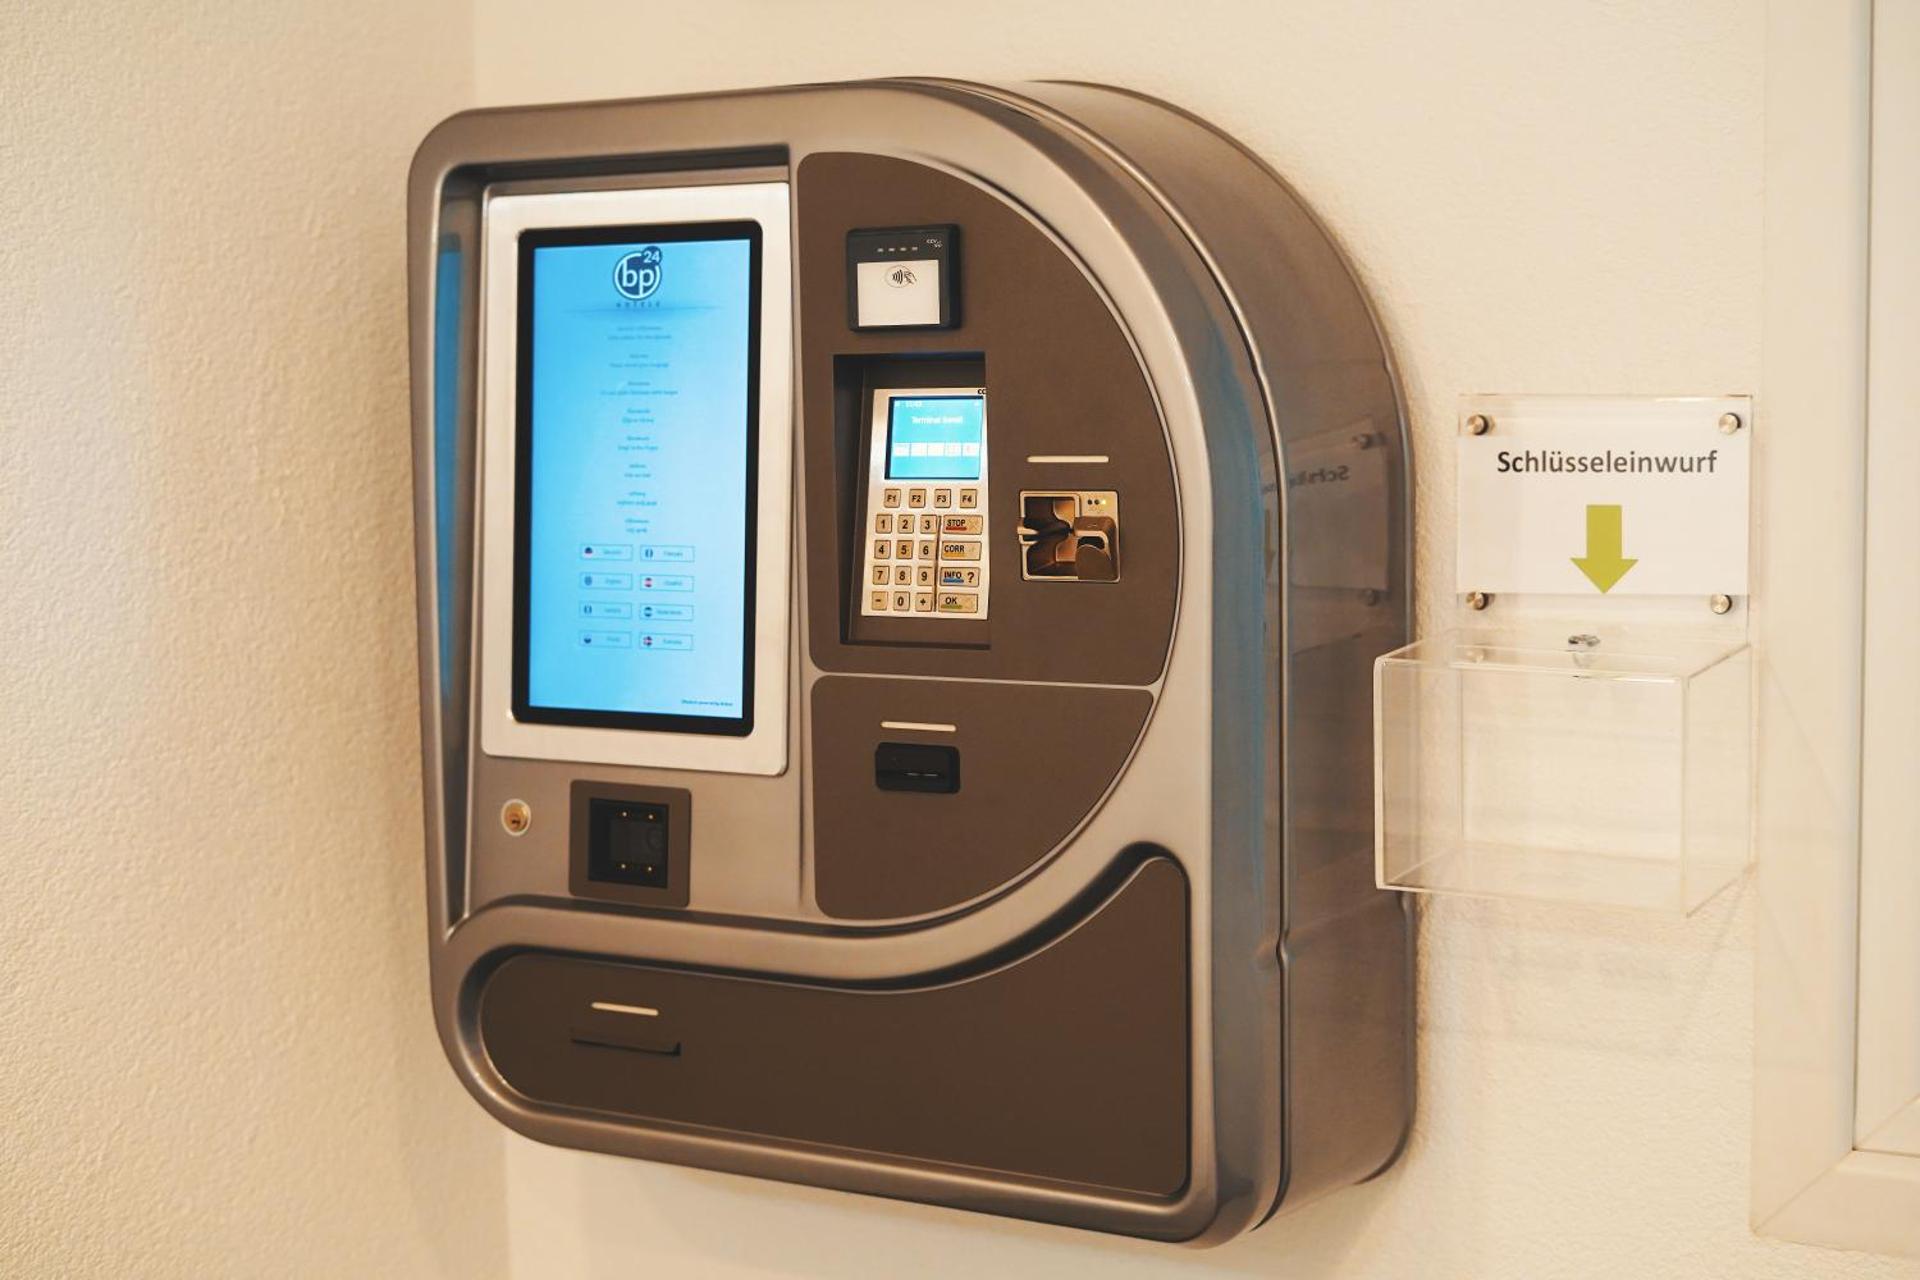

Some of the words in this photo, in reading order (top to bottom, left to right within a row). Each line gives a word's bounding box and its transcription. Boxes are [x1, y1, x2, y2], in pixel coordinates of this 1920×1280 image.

[643, 250, 660, 263] 24
[622, 259, 655, 297] bp
[1497, 450, 1718, 474] Schlüsseleinwurf
[887, 495, 896, 503] F1
[911, 494, 921, 503] F2
[936, 495, 946, 503] F3
[962, 495, 972, 503] F4
[881, 520, 886, 529] 1
[902, 520, 909, 529] 2
[925, 520, 931, 530] 3
[878, 545, 885, 554] 4
[901, 545, 906, 554] 5
[923, 546, 929, 555] 6
[877, 570, 883, 580] 7
[899, 571, 906, 580] 8
[921, 571, 928, 581] 9
[944, 571, 962, 579] INFO
[967, 572, 975, 583] ?
[897, 597, 904, 606] 0
[945, 597, 957, 605] OK
